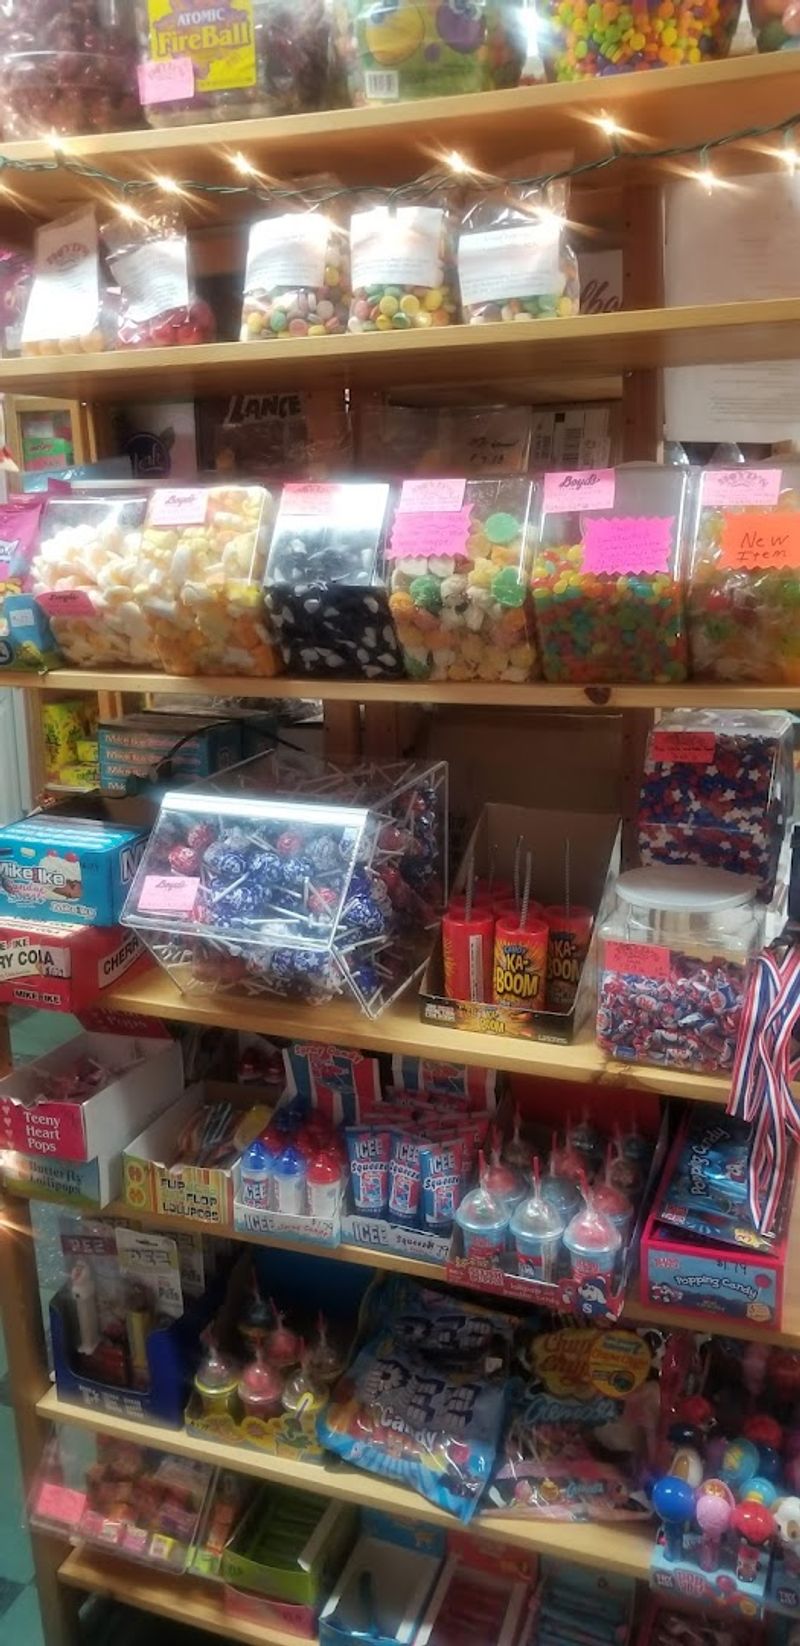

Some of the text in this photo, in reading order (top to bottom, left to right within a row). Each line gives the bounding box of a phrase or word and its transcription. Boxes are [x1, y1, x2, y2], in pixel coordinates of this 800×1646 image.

[177, 7, 226, 27] ATOMIC
[156, 20, 251, 58] FireBall
[741, 531, 790, 549] New
[736, 549, 787, 561] Item
[108, 782, 126, 792] Mik
[37, 867, 65, 886] Ike
[18, 949, 55, 967] COLA
[103, 936, 141, 976] CHERR
[495, 966, 540, 997] BOOM
[23, 1111, 61, 1129] Teeny
[26, 1125, 61, 1141] Heart
[27, 1138, 57, 1153] Pops
[355, 1138, 383, 1159] ICEE
[396, 1142, 420, 1161] ICEE
[430, 1152, 455, 1175] ICEE
[160, 1178, 185, 1190] FLIP
[186, 1193, 218, 1206] FLOP
[162, 1202, 219, 1222] LOLLIPOPS
[244, 1213, 274, 1233] ICEE
[352, 1221, 389, 1245] ICEE
[674, 1275, 758, 1301] Popping Candy
[365, 1358, 483, 1430] PEZ
[380, 1405, 438, 1447] Candy
